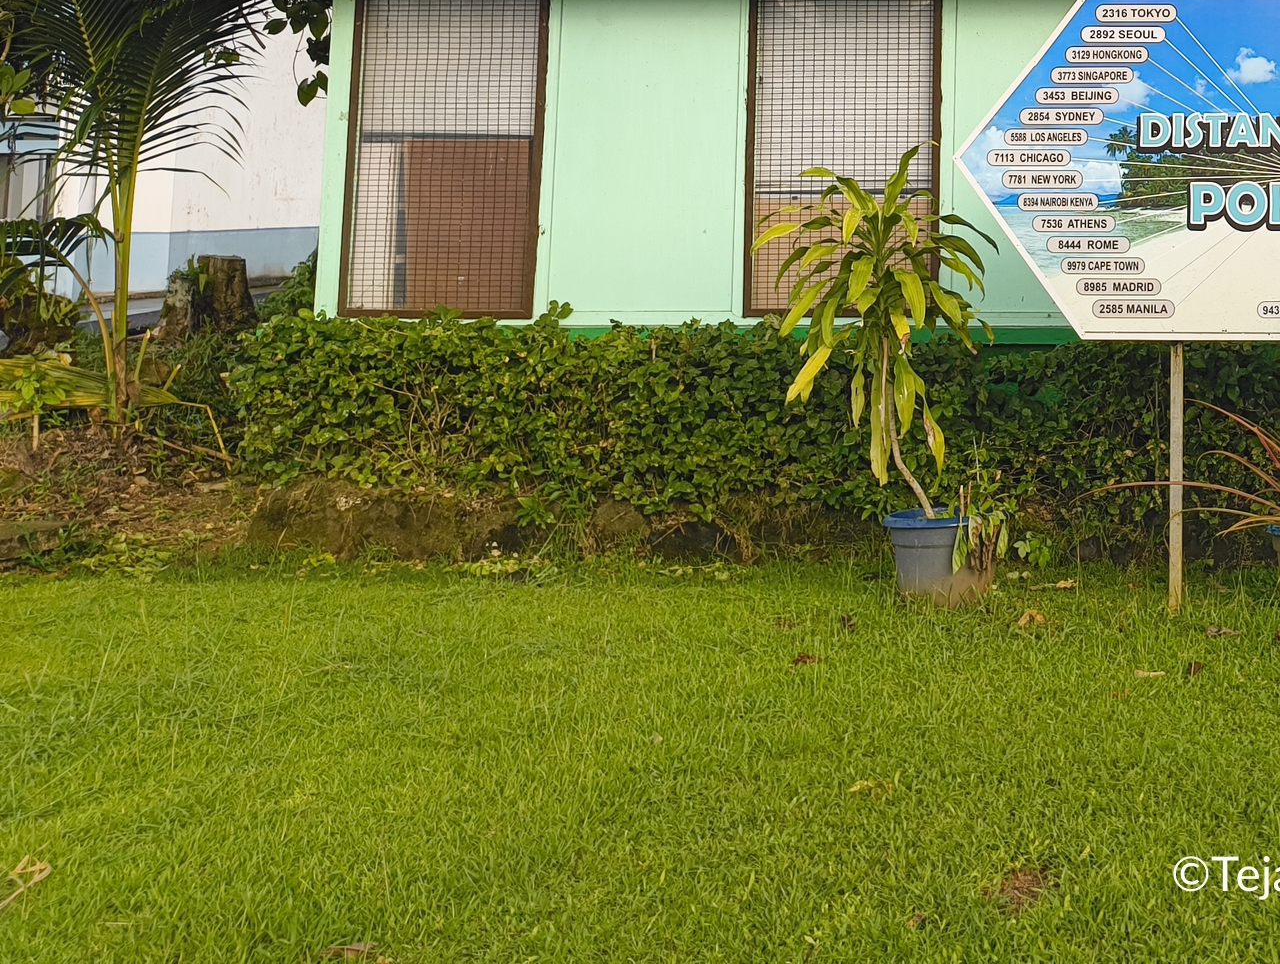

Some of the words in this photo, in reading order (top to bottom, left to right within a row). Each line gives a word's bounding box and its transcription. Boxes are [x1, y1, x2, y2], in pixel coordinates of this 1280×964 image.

[1101, 8, 1128, 19] 2316
[1130, 8, 1171, 19] TOKYO
[1089, 29, 1116, 40] 2892
[1118, 29, 1158, 40] SEOUL
[1071, 49, 1091, 60] 3129
[1092, 49, 1142, 60] HONGKONG
[1057, 70, 1076, 82] 3773
[1077, 70, 1128, 82] SINGAPORE
[1042, 90, 1066, 102] 3453
[1070, 90, 1112, 102] BEIJING
[1027, 111, 1050, 122] 2854
[1054, 111, 1096, 122] SYDNEY
[1010, 132, 1027, 143] 5588
[1030, 132, 1046, 143] LOS
[1047, 132, 1082, 143] ANGELES
[994, 152, 1015, 163] 7113
[1019, 152, 1064, 163] CHICAGO
[1008, 174, 1027, 185] 7781
[1031, 174, 1052, 185] NEW
[1052, 174, 1077, 185] YORK
[1023, 196, 1039, 207] 8394
[1040, 196, 1069, 207] NAIROBI
[1069, 196, 1094, 207] KENYA
[1040, 218, 1063, 229] 7536
[1066, 218, 1108, 229] ATHENS
[1057, 239, 1082, 250] 8444
[1087, 239, 1120, 250] ROME
[1066, 260, 1087, 271] 9979
[1087, 260, 1112, 271] CAPE
[1113, 260, 1139, 271] TOWN
[1083, 282, 1108, 293] 8985
[1112, 282, 1154, 293] MADRID
[1098, 303, 1124, 314] 2585
[1126, 303, 1169, 314] MANILA
